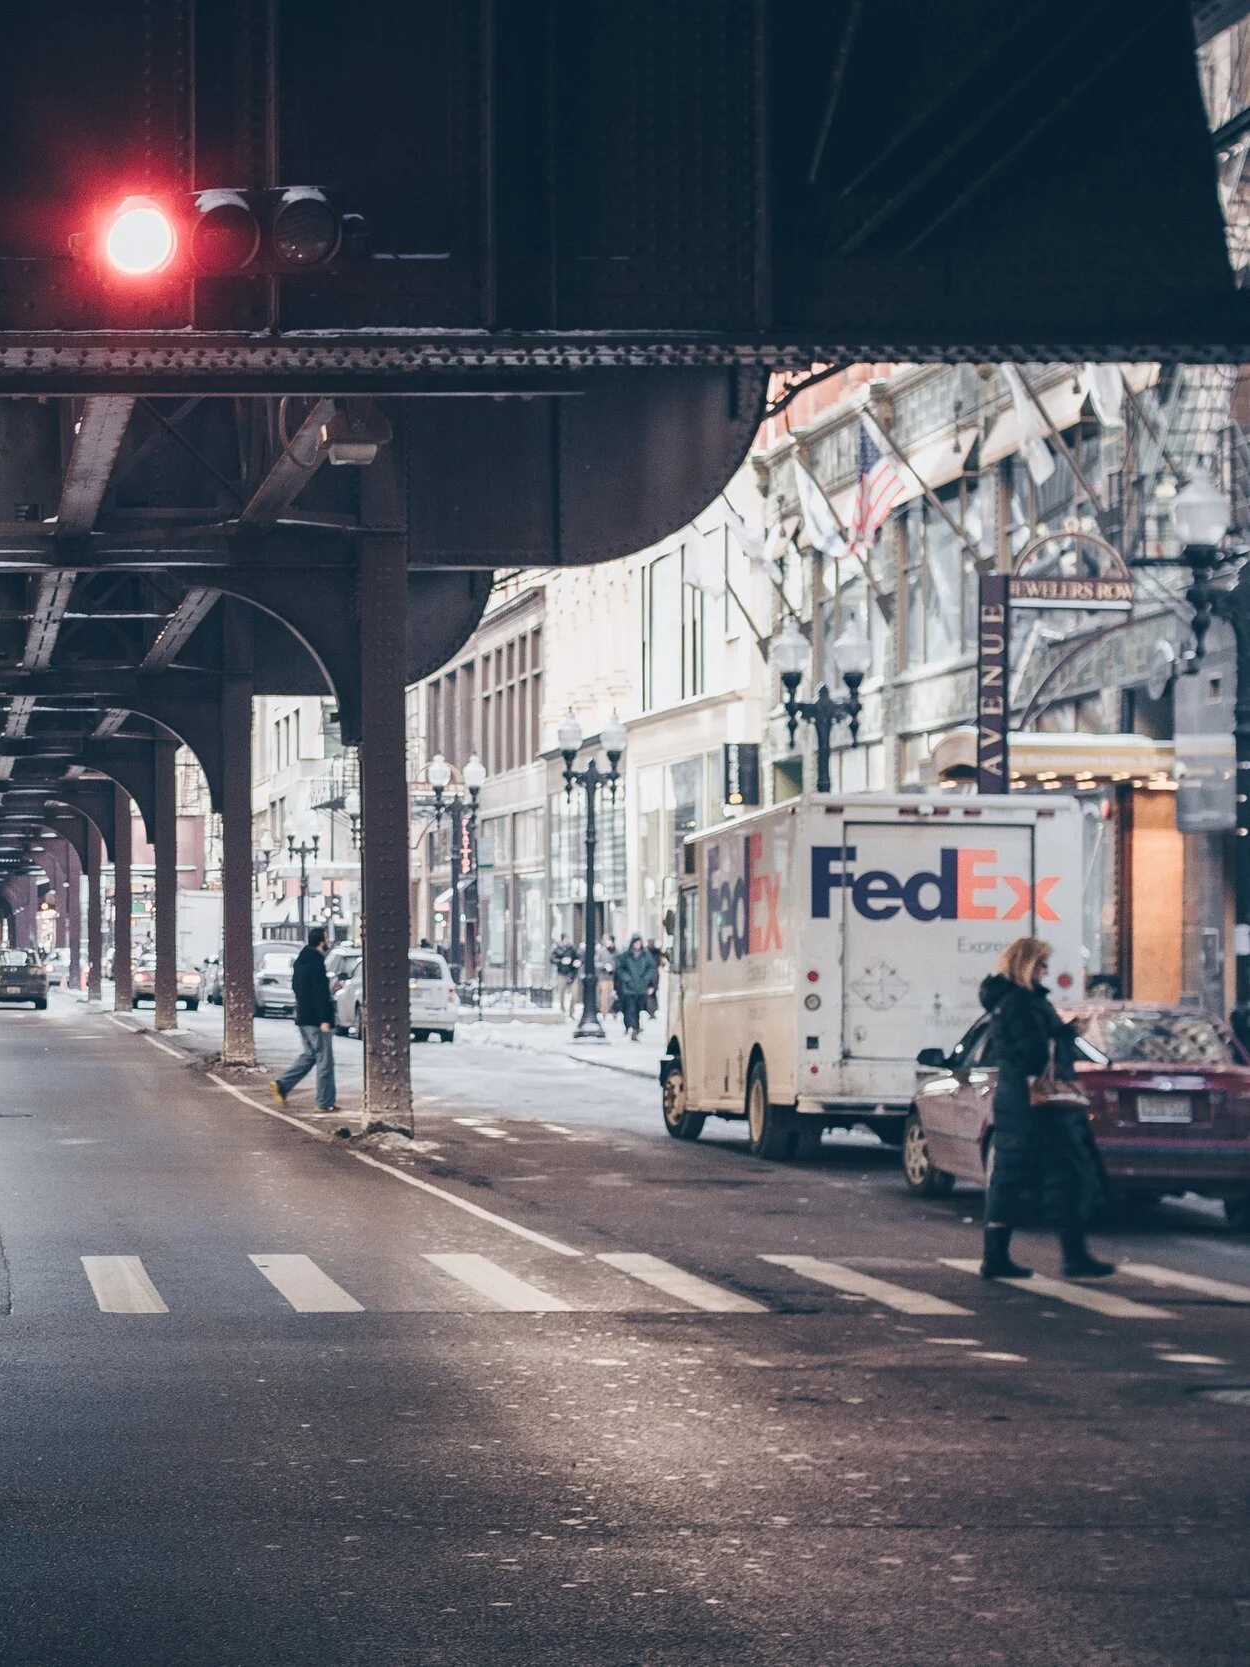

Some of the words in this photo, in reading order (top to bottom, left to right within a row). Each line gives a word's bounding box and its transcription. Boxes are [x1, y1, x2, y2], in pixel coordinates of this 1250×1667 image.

[1097, 582, 1133, 600] ROW
[979, 603, 1004, 776] AVENUE
[707, 832, 783, 961] FedEx
[811, 846, 1062, 921] FedEx
